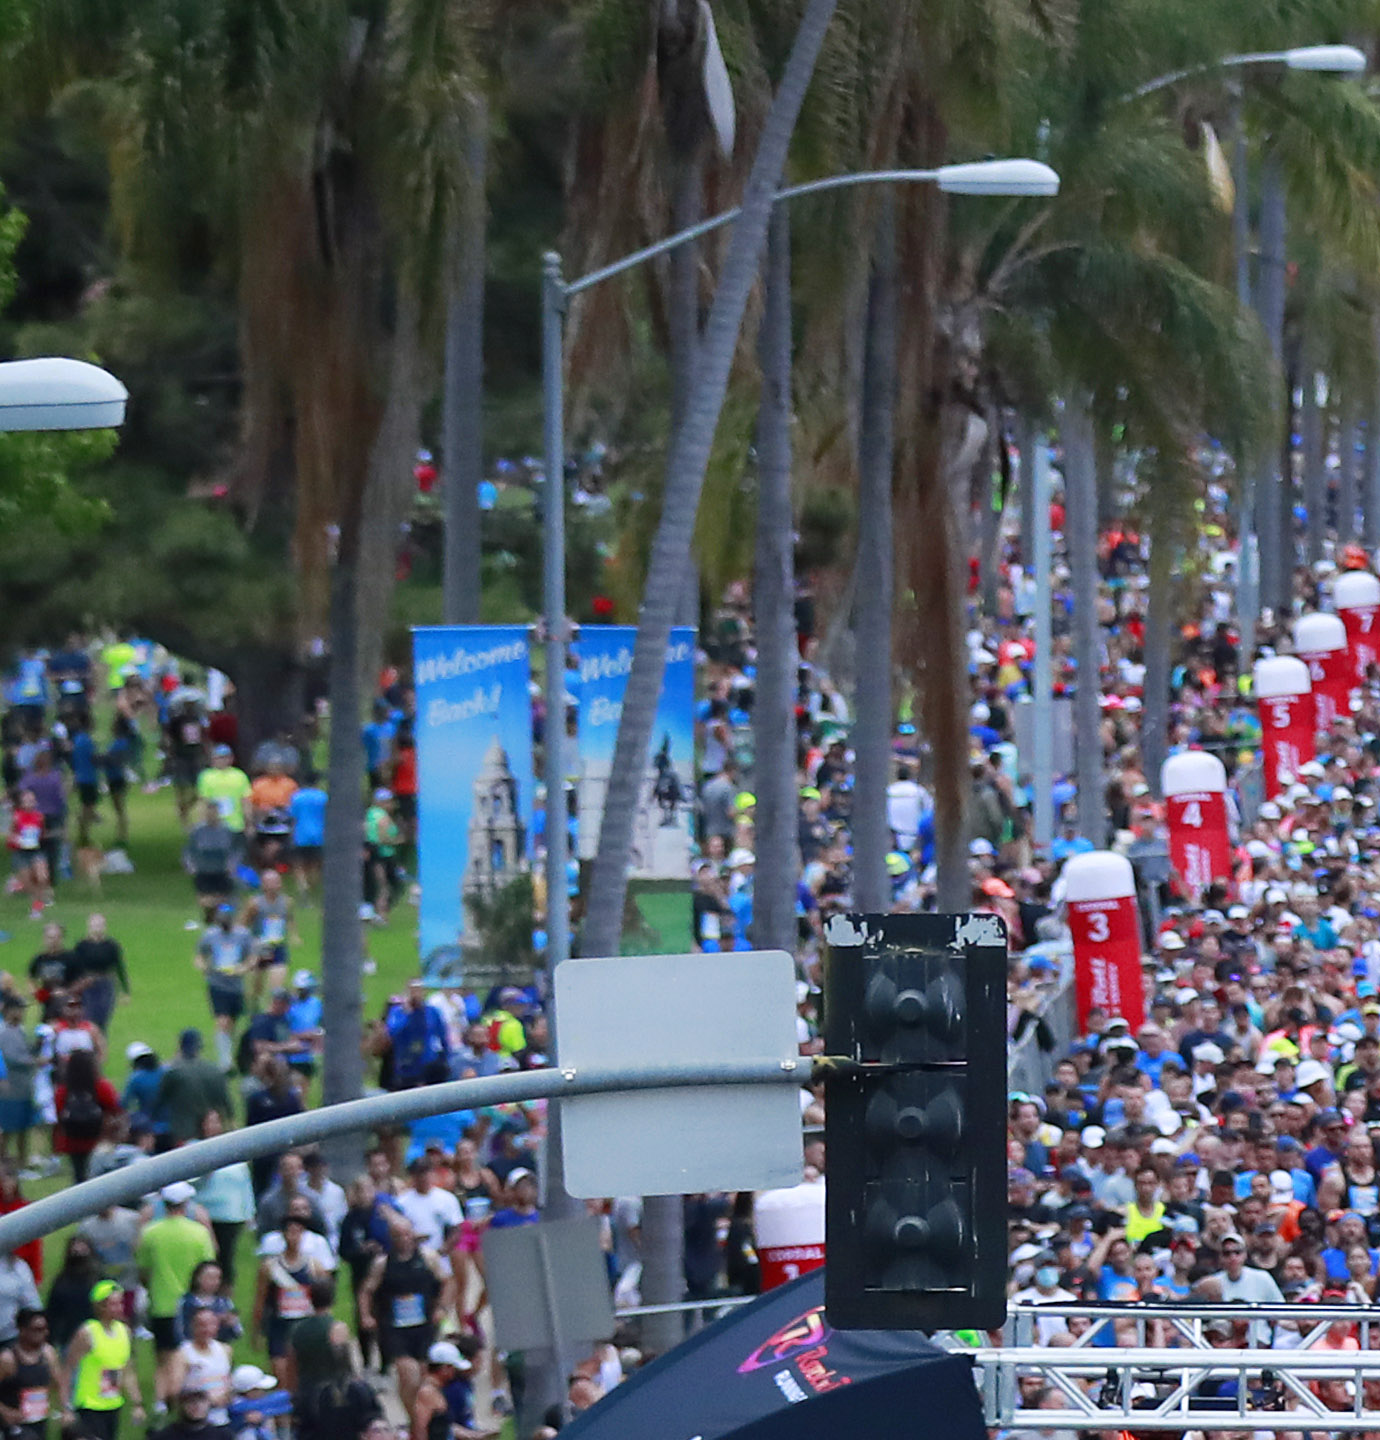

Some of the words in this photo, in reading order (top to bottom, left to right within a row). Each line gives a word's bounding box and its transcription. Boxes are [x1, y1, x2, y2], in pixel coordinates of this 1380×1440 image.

[1358, 612, 1374, 633] 7
[1272, 704, 1291, 728] 5
[1181, 801, 1204, 828] 4
[1087, 911, 1110, 942] 3
